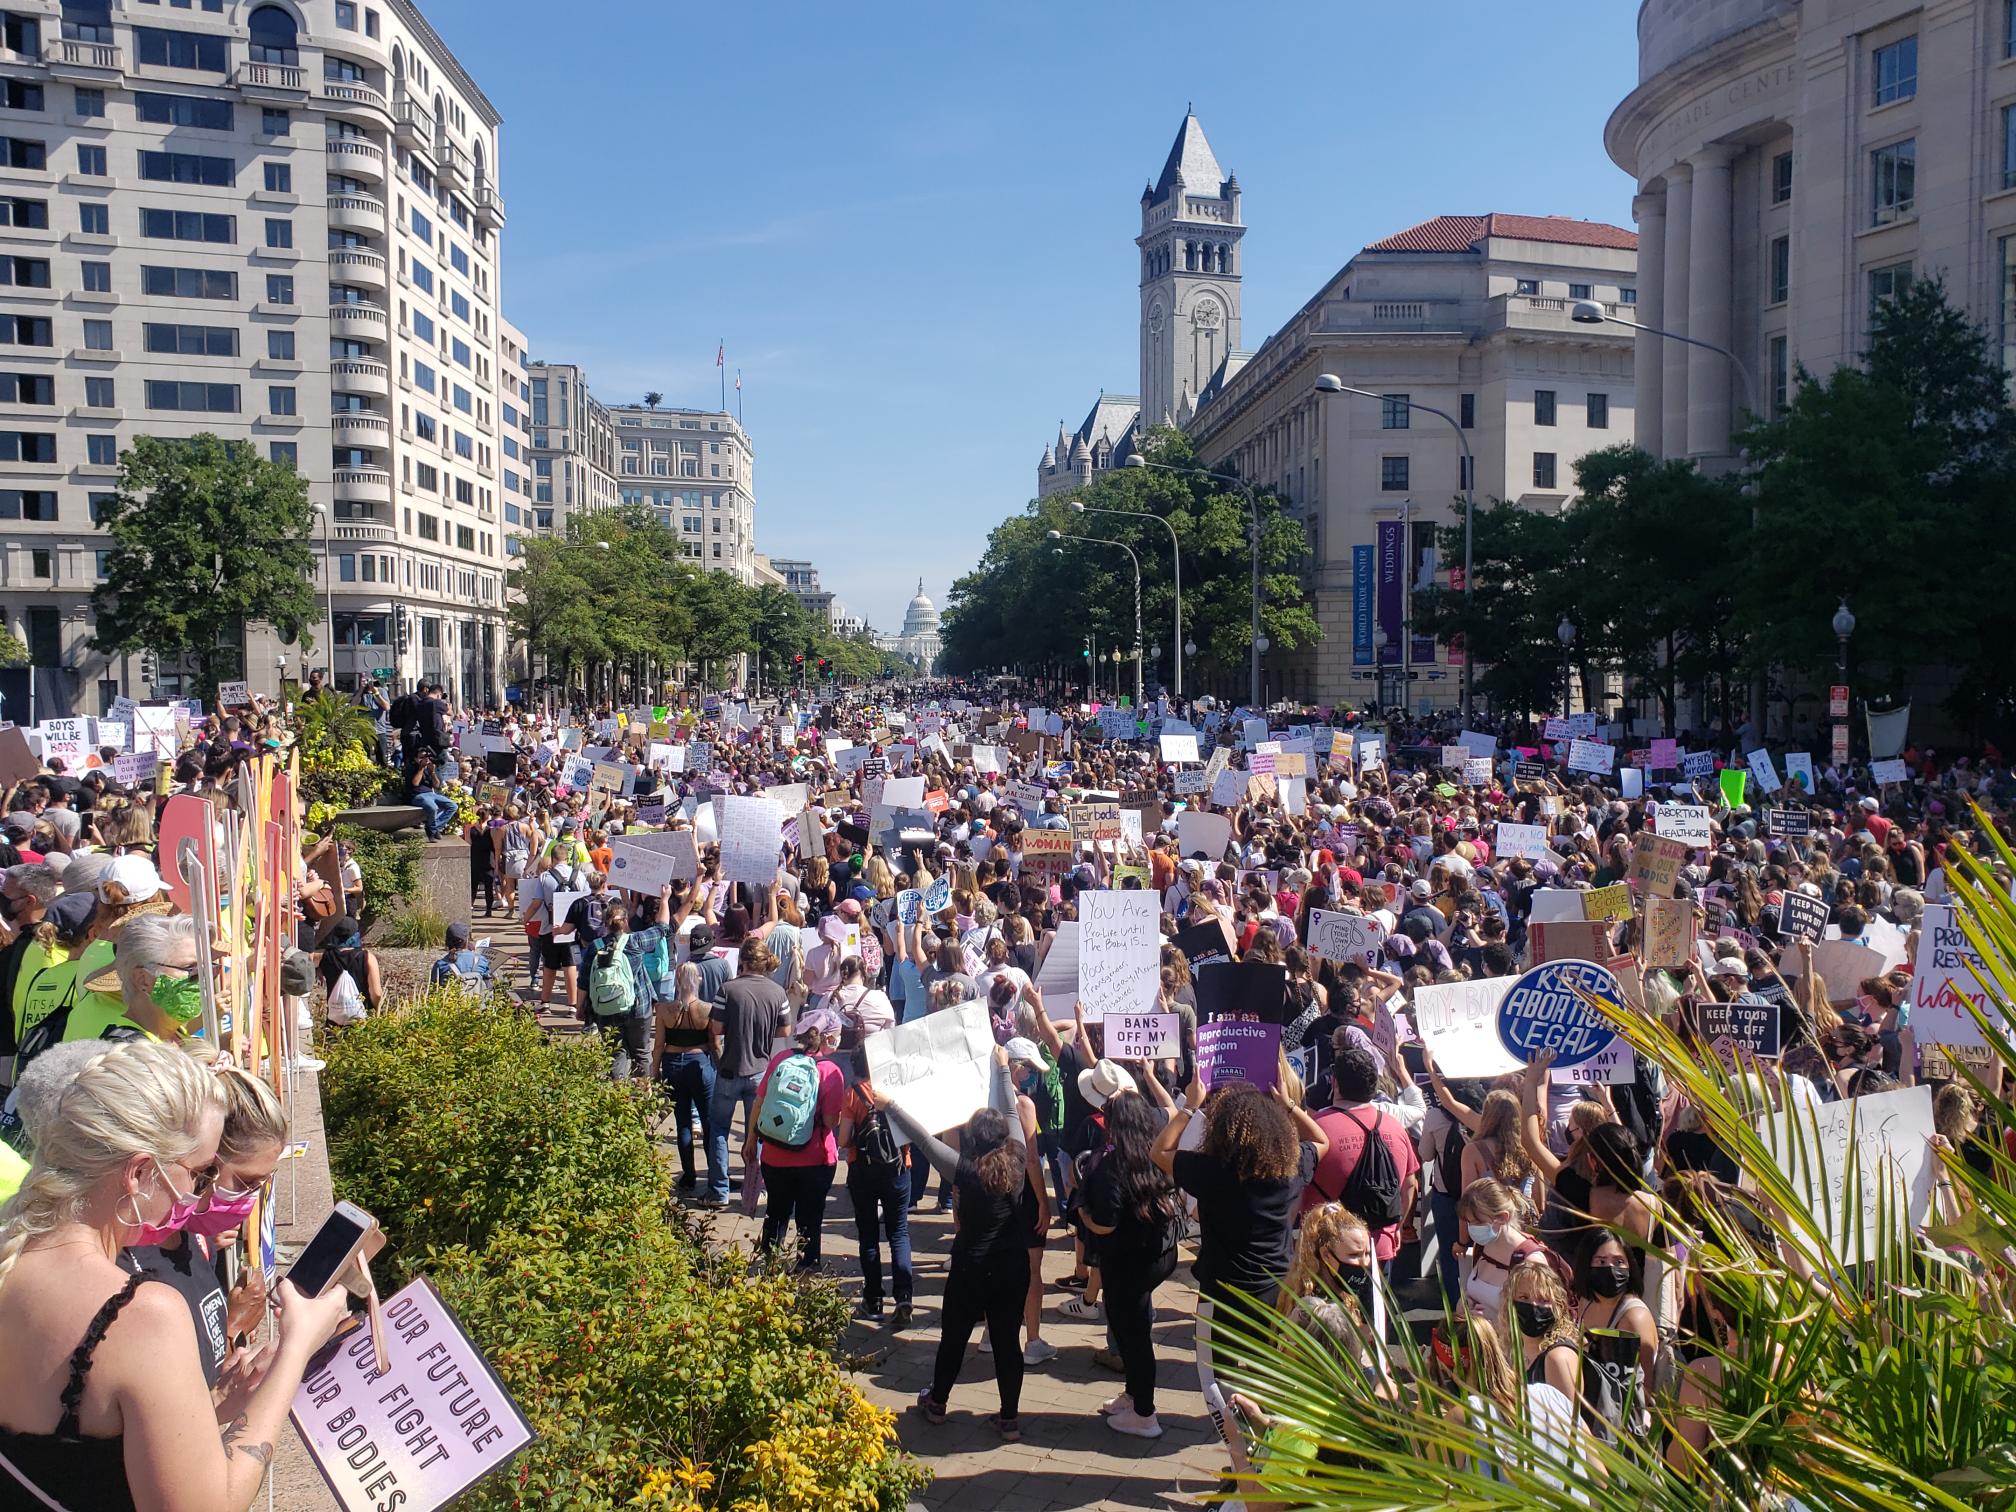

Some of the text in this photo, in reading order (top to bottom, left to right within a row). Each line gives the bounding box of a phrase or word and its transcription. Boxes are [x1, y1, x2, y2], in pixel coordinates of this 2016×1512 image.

[1385, 527, 1395, 583] WEDDINGS
[1359, 550, 1368, 646] WORLD TRADE CENTER
[49, 720, 75, 731] BOYS
[45, 731, 81, 742] WILL BE
[1684, 757, 1695, 766] MY
[1685, 767, 1696, 775] MY
[1005, 790, 1019, 798] ARE
[1071, 805, 1120, 822] Their bodies
[1657, 807, 1704, 819] ABORTION
[1071, 822, 1121, 840] Their choices
[1657, 829, 1710, 839] HEALTHCARE
[1025, 838, 1071, 851] WOMAN
[1024, 859, 1069, 871] WOMB
[1656, 859, 1675, 872] OUR
[1638, 867, 1669, 884] BODIES
[1604, 887, 1617, 895] MY
[1123, 899, 1150, 918] Are
[1595, 895, 1628, 909] CHOICE
[1791, 897, 1826, 918] KEEP YOUR
[1791, 911, 1823, 928] LAWS OFF
[1334, 924, 1349, 933] MIND
[1334, 931, 1350, 939] YOUR
[1792, 922, 1818, 938] MY BODY
[1335, 937, 1349, 945] OWN
[1733, 930, 1753, 946] BANS
[1083, 939, 1127, 953] The Baby
[1323, 949, 1356, 962] UTERUS
[1535, 965, 1612, 994] KEEP
[29, 999, 55, 1010] IT'S A
[1419, 988, 1454, 1031] MY
[1207, 1011, 1260, 1023] I am an
[1706, 1009, 1768, 1021] KEEP YOUR
[1124, 1017, 1159, 1028] BANS
[1199, 1026, 1267, 1042] Reproductive
[1709, 1024, 1766, 1035] LAWS OFF
[1117, 1031, 1167, 1042] OFF MY
[1509, 1021, 1599, 1056] LEGAL
[1124, 1045, 1160, 1056] BODY
[1199, 1041, 1238, 1056] Freedom
[1199, 1055, 1226, 1069] For All.
[1597, 1052, 1618, 1065] MY
[1573, 1069, 1612, 1081] BODY
[1338, 1136, 1350, 1145] WE
[387, 1297, 504, 1454] OUR FUTURE
[347, 1334, 450, 1471] OUR FIGHT
[326, 1406, 407, 1512] BODIES
